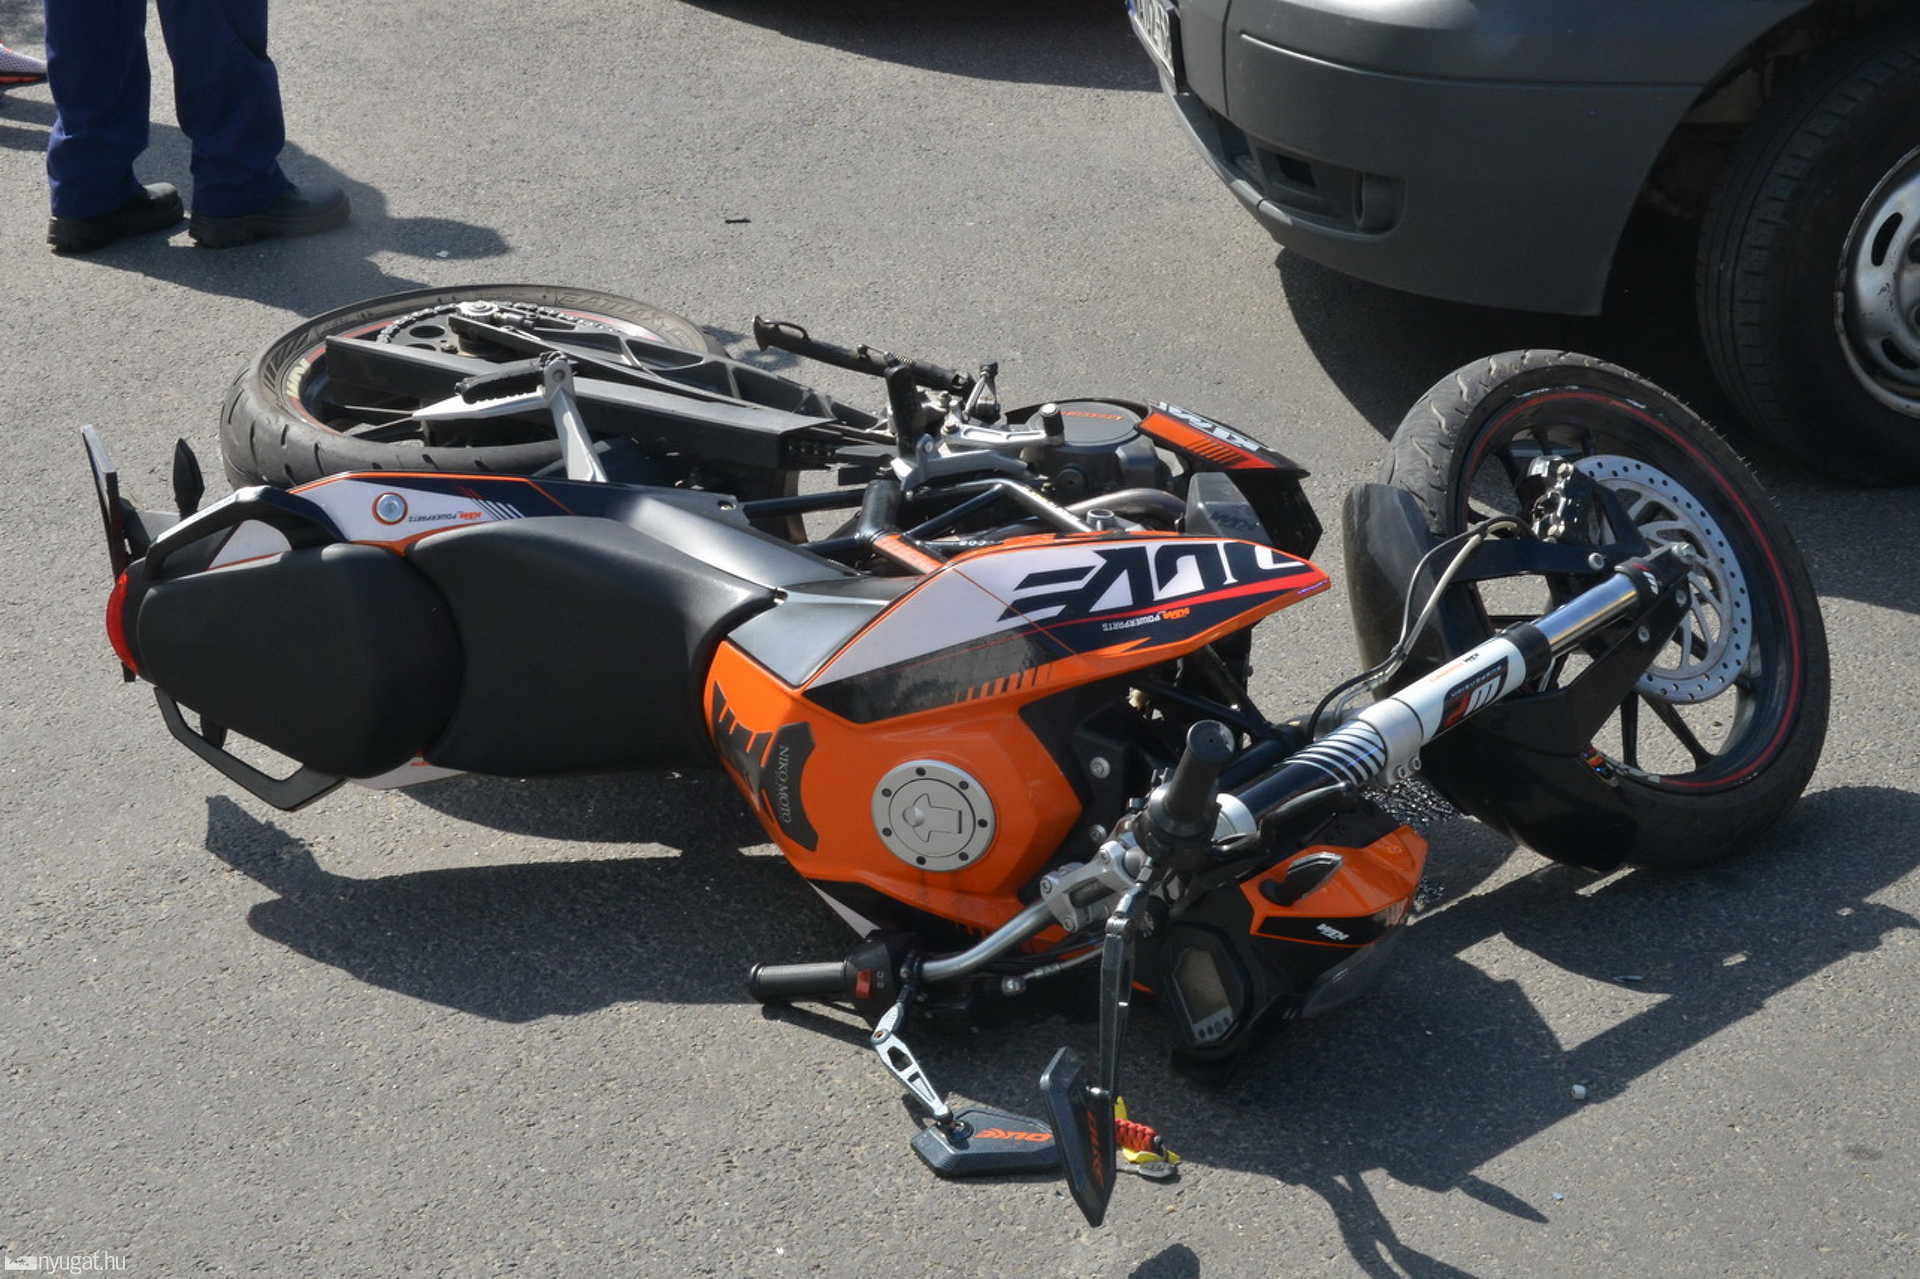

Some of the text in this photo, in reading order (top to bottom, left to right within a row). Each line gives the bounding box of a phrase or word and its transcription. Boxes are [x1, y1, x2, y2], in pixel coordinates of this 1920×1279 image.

[408, 512, 459, 522] POWERPARTS
[1102, 612, 1161, 631] POWERPARTS
[779, 744, 792, 823] NIKO MOTO
[974, 1127, 1053, 1142] DUKE
